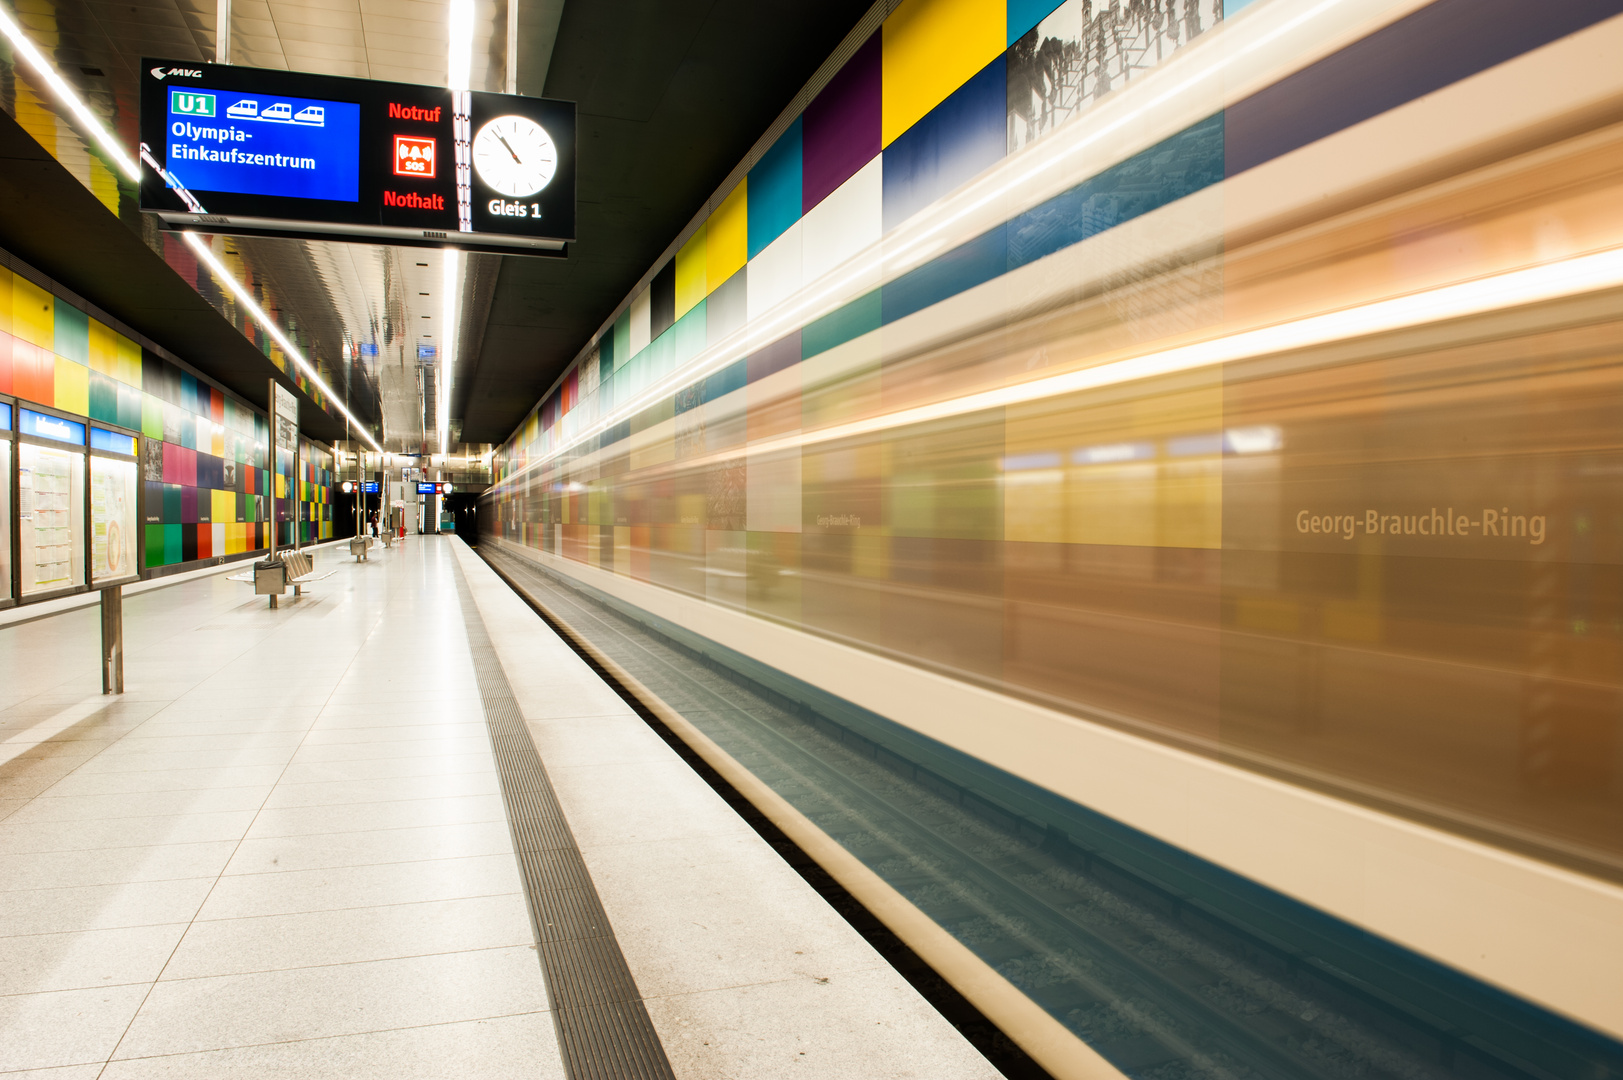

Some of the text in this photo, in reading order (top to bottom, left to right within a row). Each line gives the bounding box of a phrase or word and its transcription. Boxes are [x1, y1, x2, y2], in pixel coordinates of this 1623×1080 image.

[167, 68, 203, 79] MVG
[178, 94, 209, 114] U1
[389, 102, 441, 122] Notruf
[171, 121, 253, 144] Olympia-
[171, 143, 316, 170] Einkaufszentrum
[405, 160, 425, 172] SOS
[384, 190, 444, 210] Nothalt
[488, 199, 542, 218] Gleis 1
[1296, 506, 1546, 545] Georg-Brauchle-Ring
